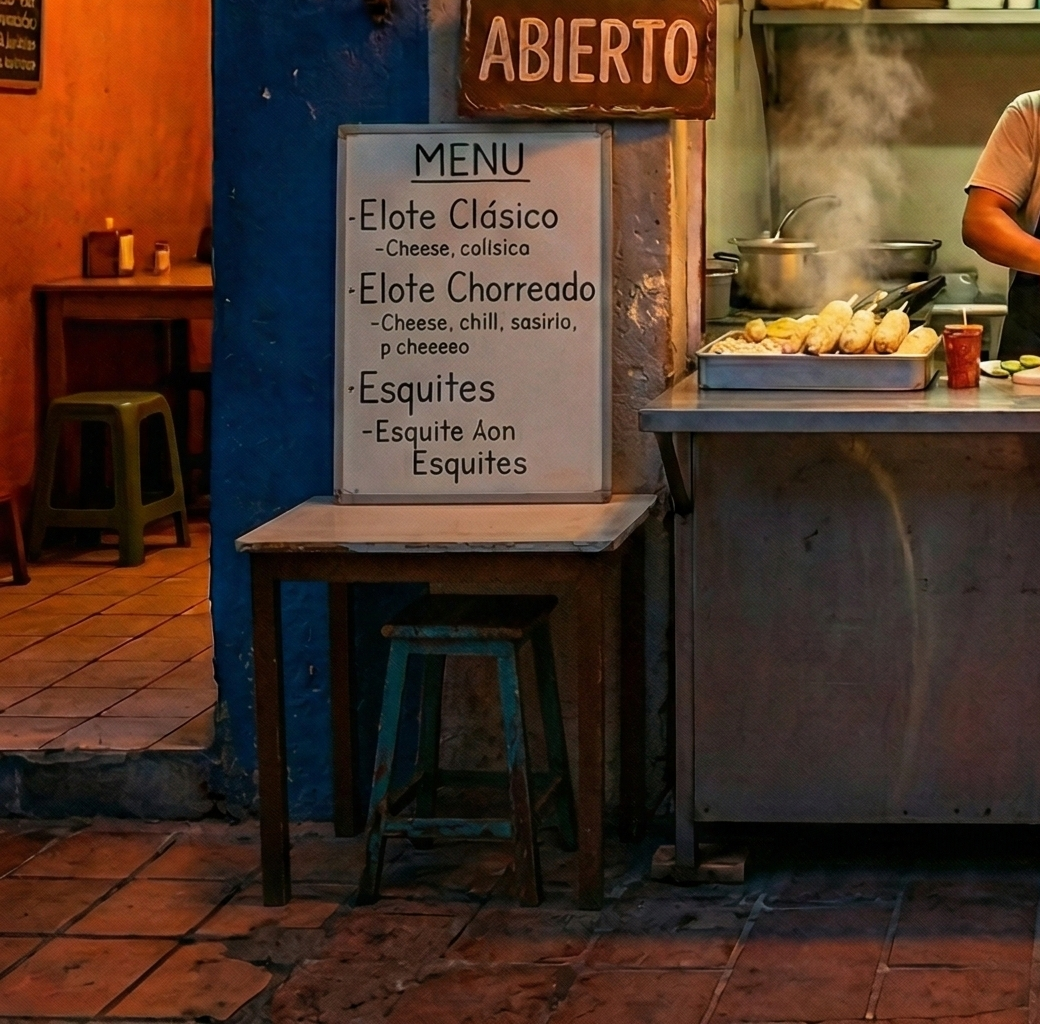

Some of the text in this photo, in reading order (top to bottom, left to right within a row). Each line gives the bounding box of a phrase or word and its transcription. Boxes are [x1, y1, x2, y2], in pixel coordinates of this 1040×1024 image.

[478, 15, 698, 85] ABIERTO
[415, 142, 524, 176] MENU
[449, 197, 559, 230] Clásico
[447, 270, 596, 303] Chorreado
[380, 338, 470, 360] p cheeeeo
[413, 450, 527, 484] Esquites
